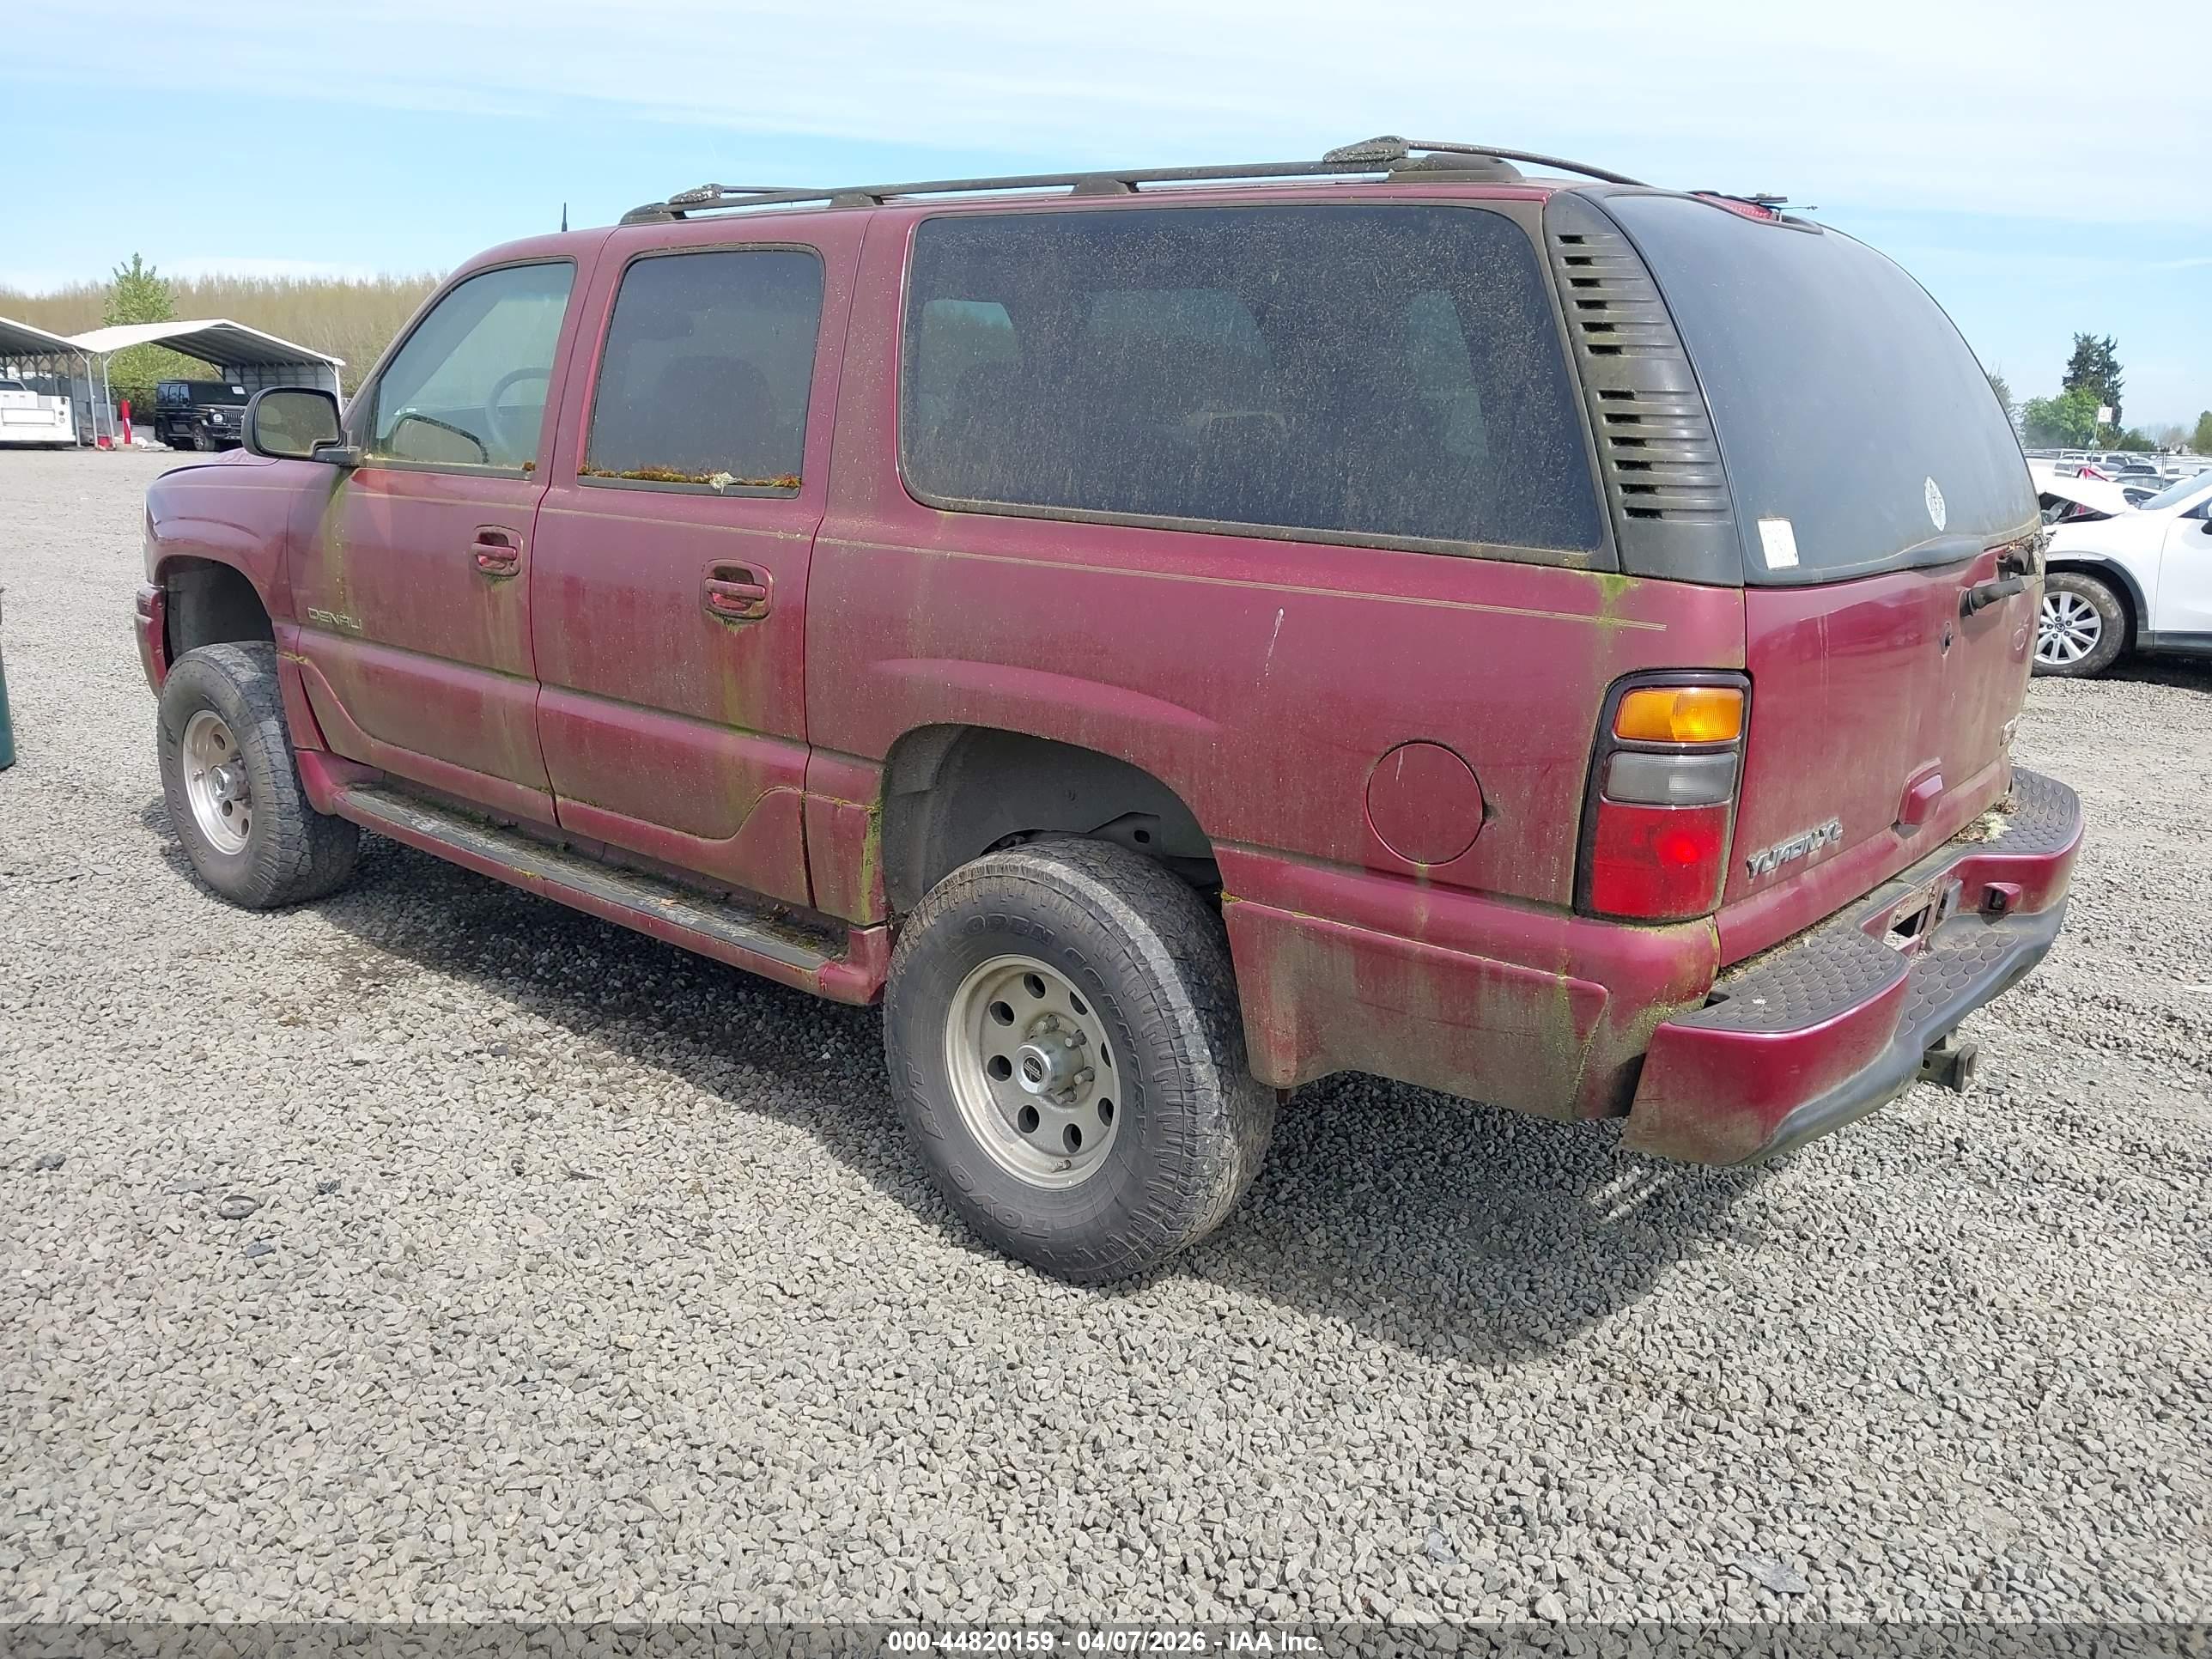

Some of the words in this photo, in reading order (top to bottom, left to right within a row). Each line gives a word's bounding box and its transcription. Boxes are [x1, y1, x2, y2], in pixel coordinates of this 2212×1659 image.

[307, 606, 362, 631] DENALI
[1746, 831, 1820, 879] YUKON
[965, 912, 1055, 945] OPEN
[1064, 946, 1148, 1151] COUNTRY
[948, 1163, 1052, 1239] TOYO
